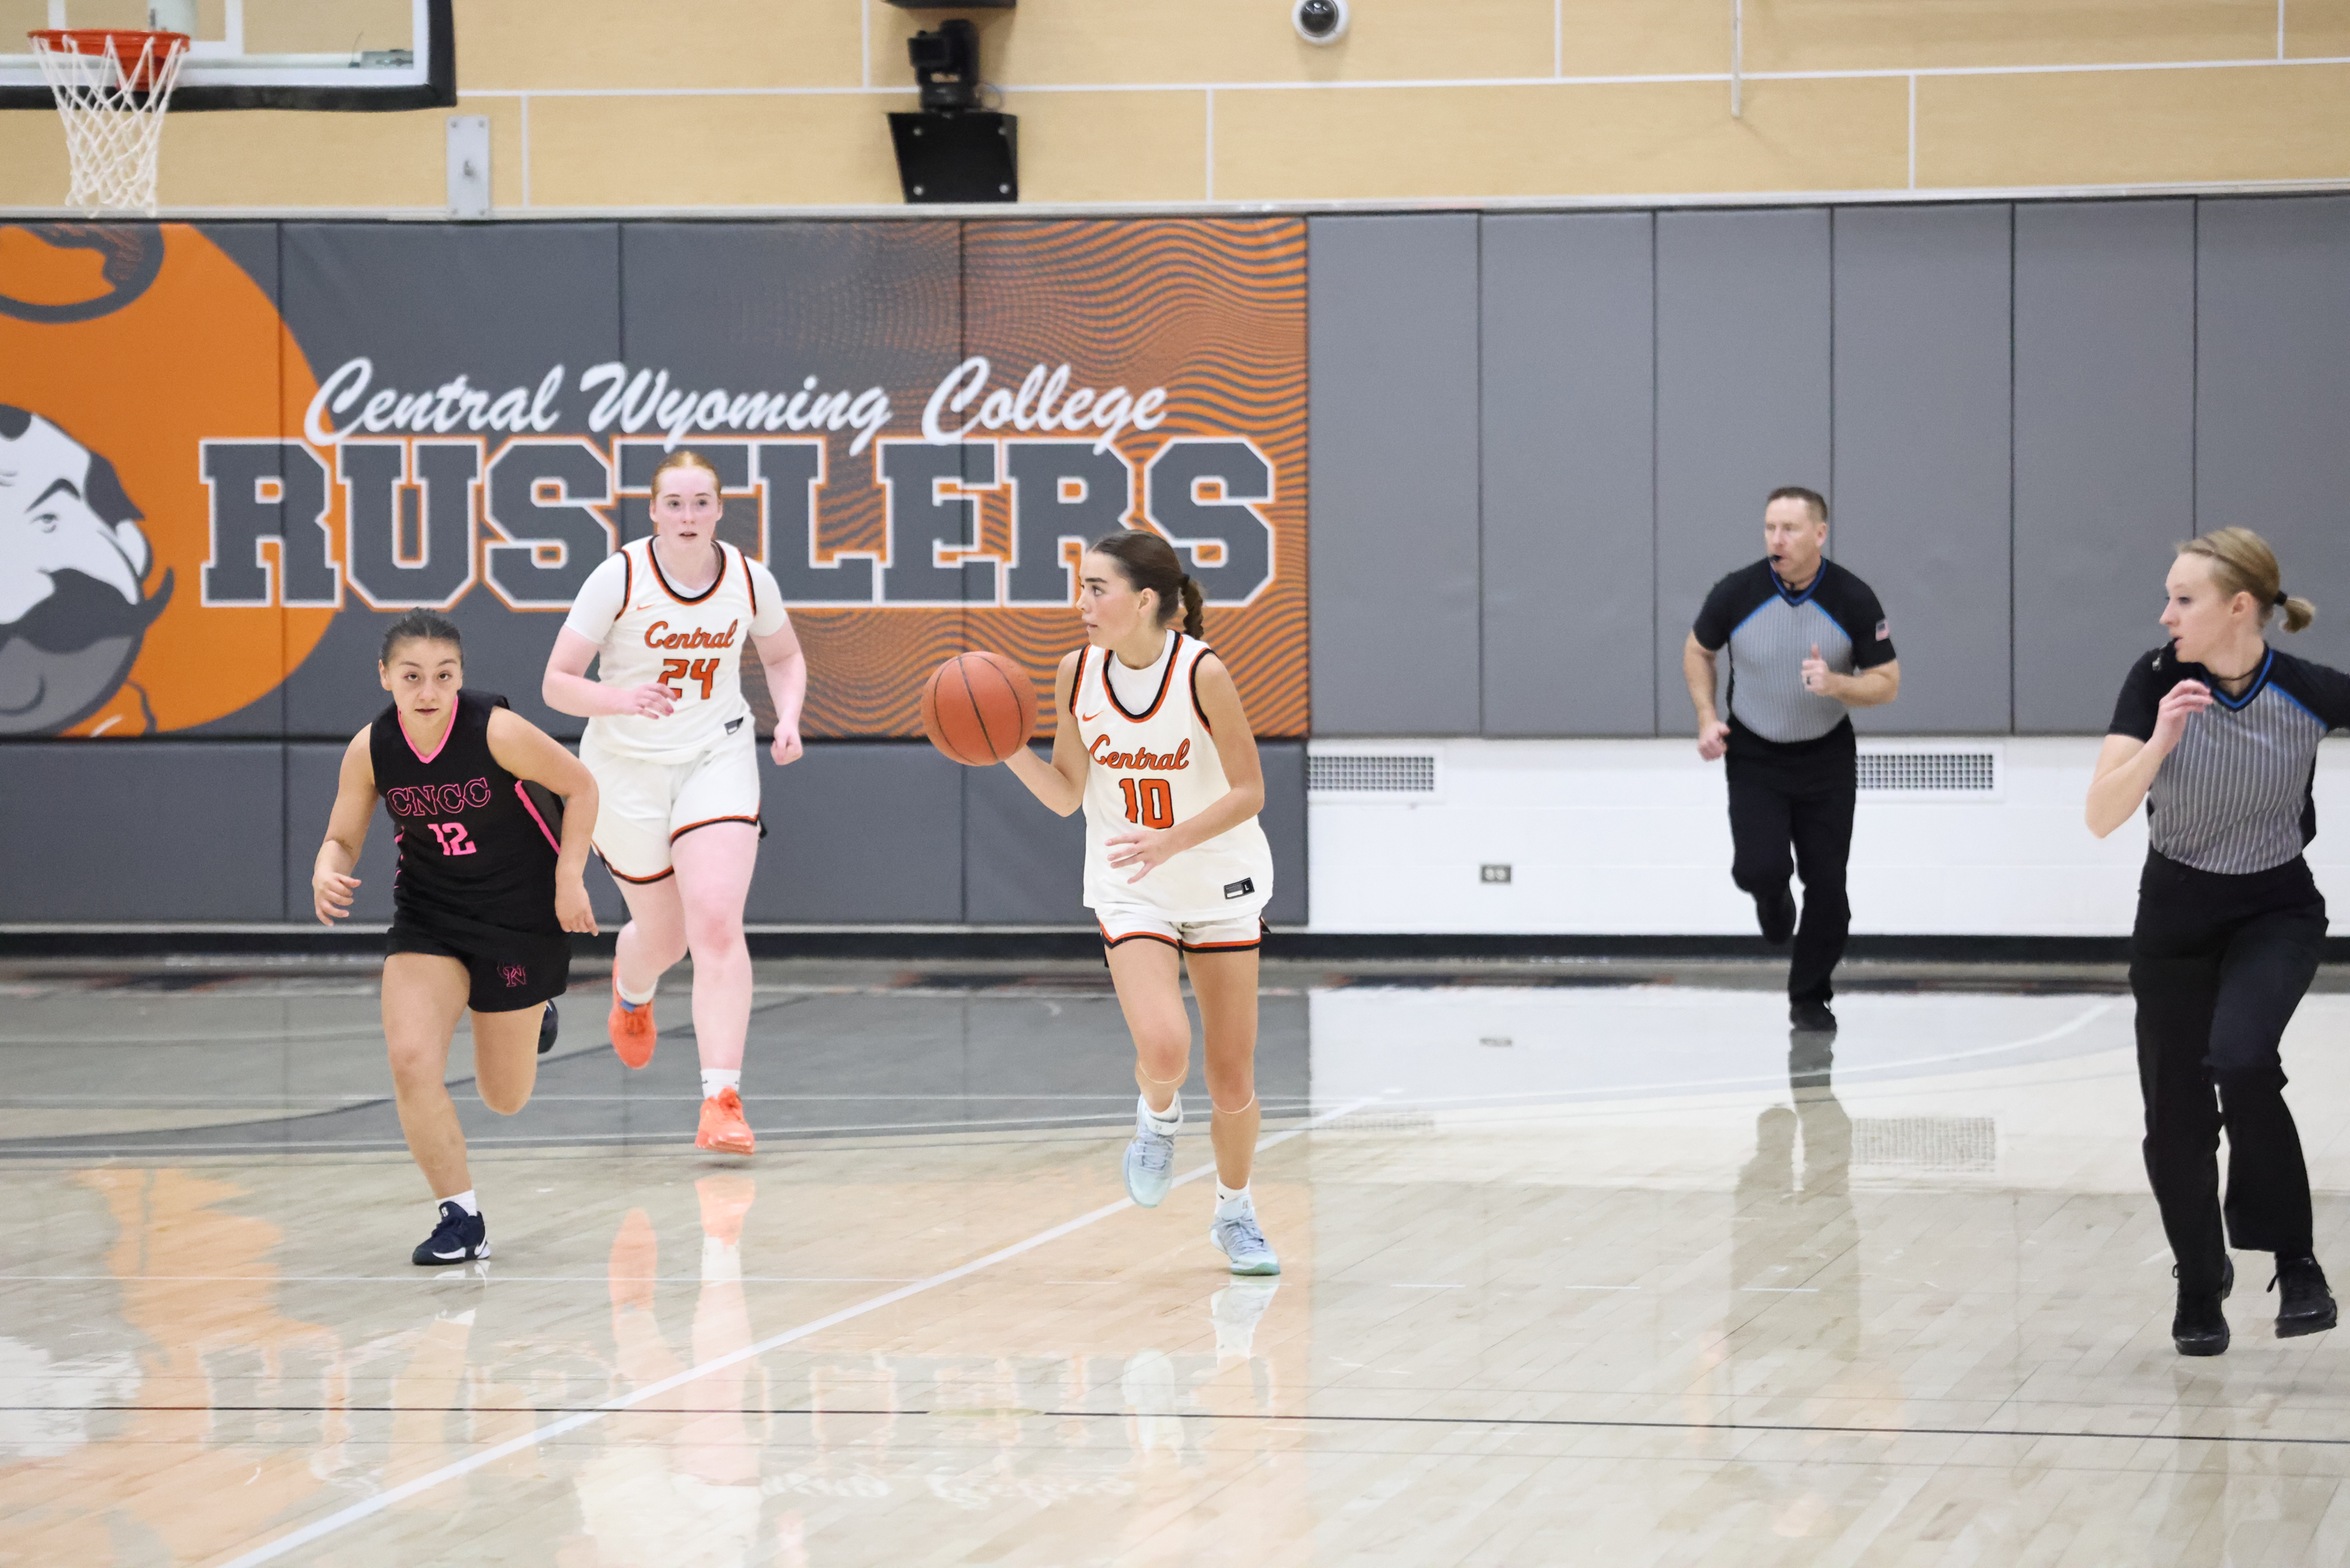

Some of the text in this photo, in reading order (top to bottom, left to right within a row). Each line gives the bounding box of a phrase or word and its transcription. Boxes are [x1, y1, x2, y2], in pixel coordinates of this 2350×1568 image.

[304, 356, 1168, 456] Central Wyoming College
[645, 619, 738, 649] Central
[657, 658, 720, 700] 24
[1089, 734, 1190, 770] Central
[387, 777, 491, 816] CNCC
[1119, 778, 1174, 829] 10
[427, 822, 477, 856] 12
